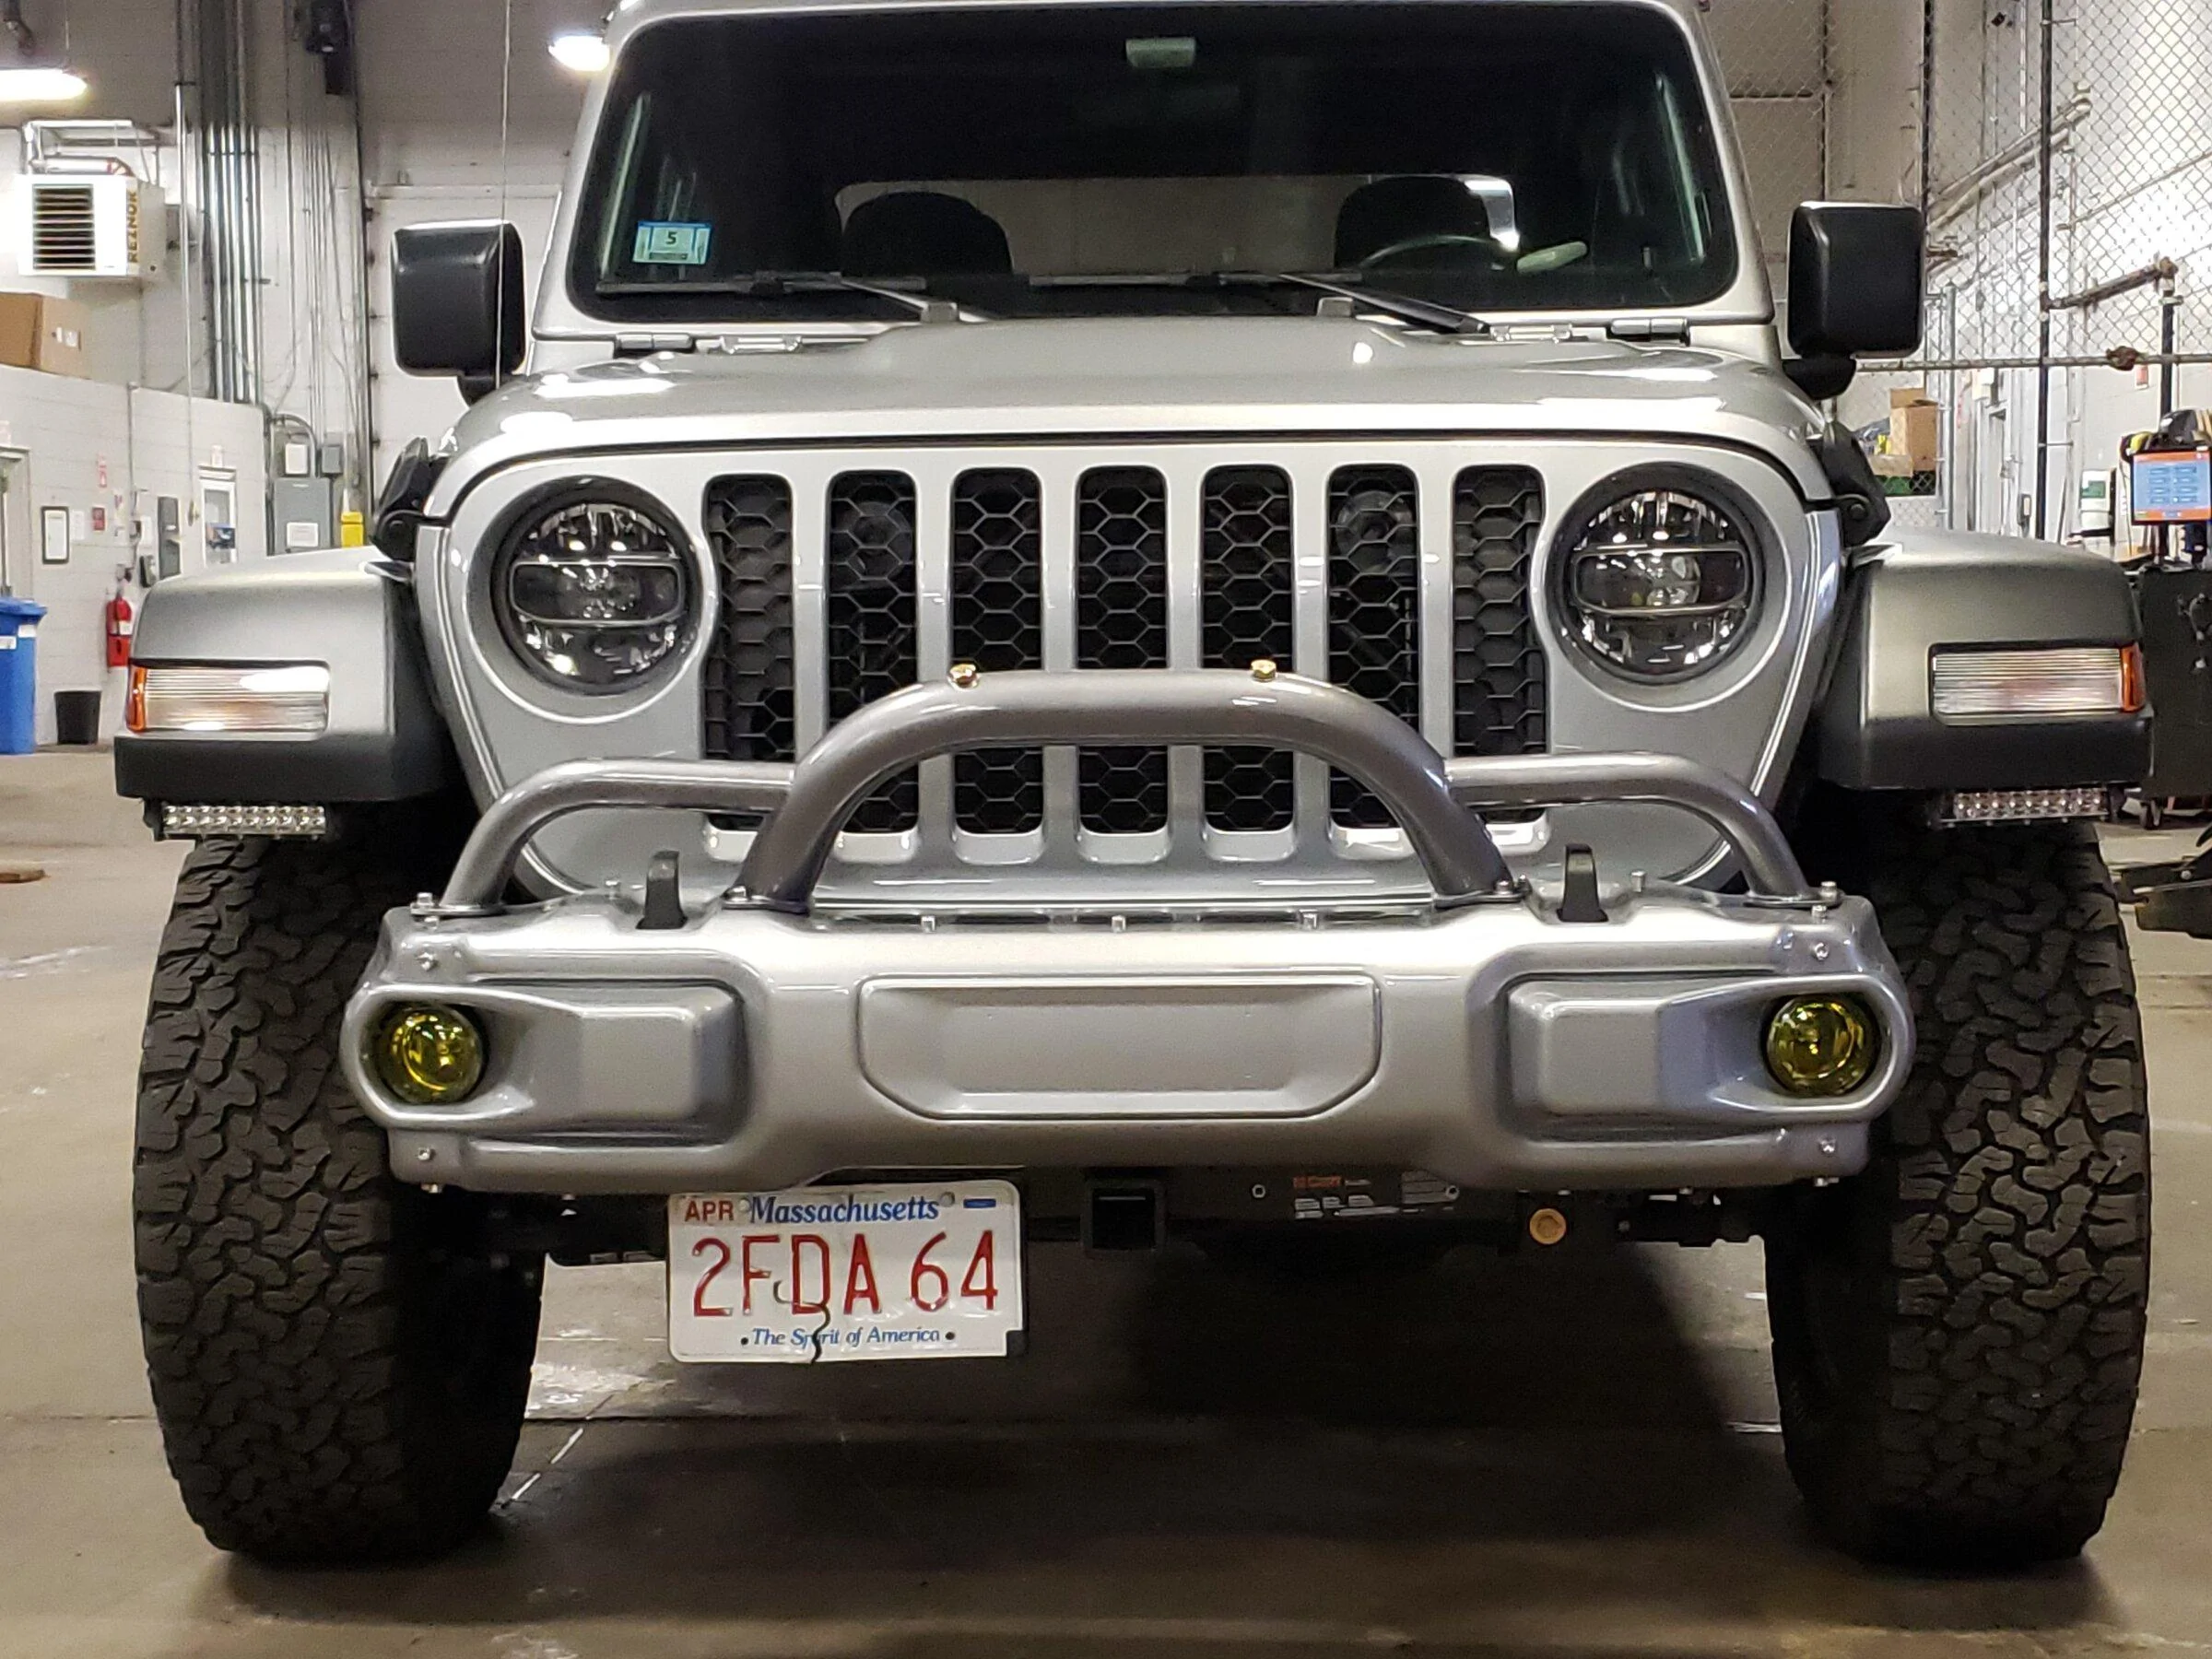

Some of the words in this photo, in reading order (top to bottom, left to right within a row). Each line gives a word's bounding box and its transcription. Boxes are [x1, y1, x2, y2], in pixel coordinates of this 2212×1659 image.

[665, 231, 677, 245] 5
[685, 1200, 734, 1222] APR
[750, 1194, 939, 1223] Massachusetts
[692, 1233, 881, 1316] 2FDA
[911, 1230, 998, 1312] 64
[752, 1328, 783, 1346] The
[846, 1327, 863, 1347] of
[866, 1325, 940, 1343] America
